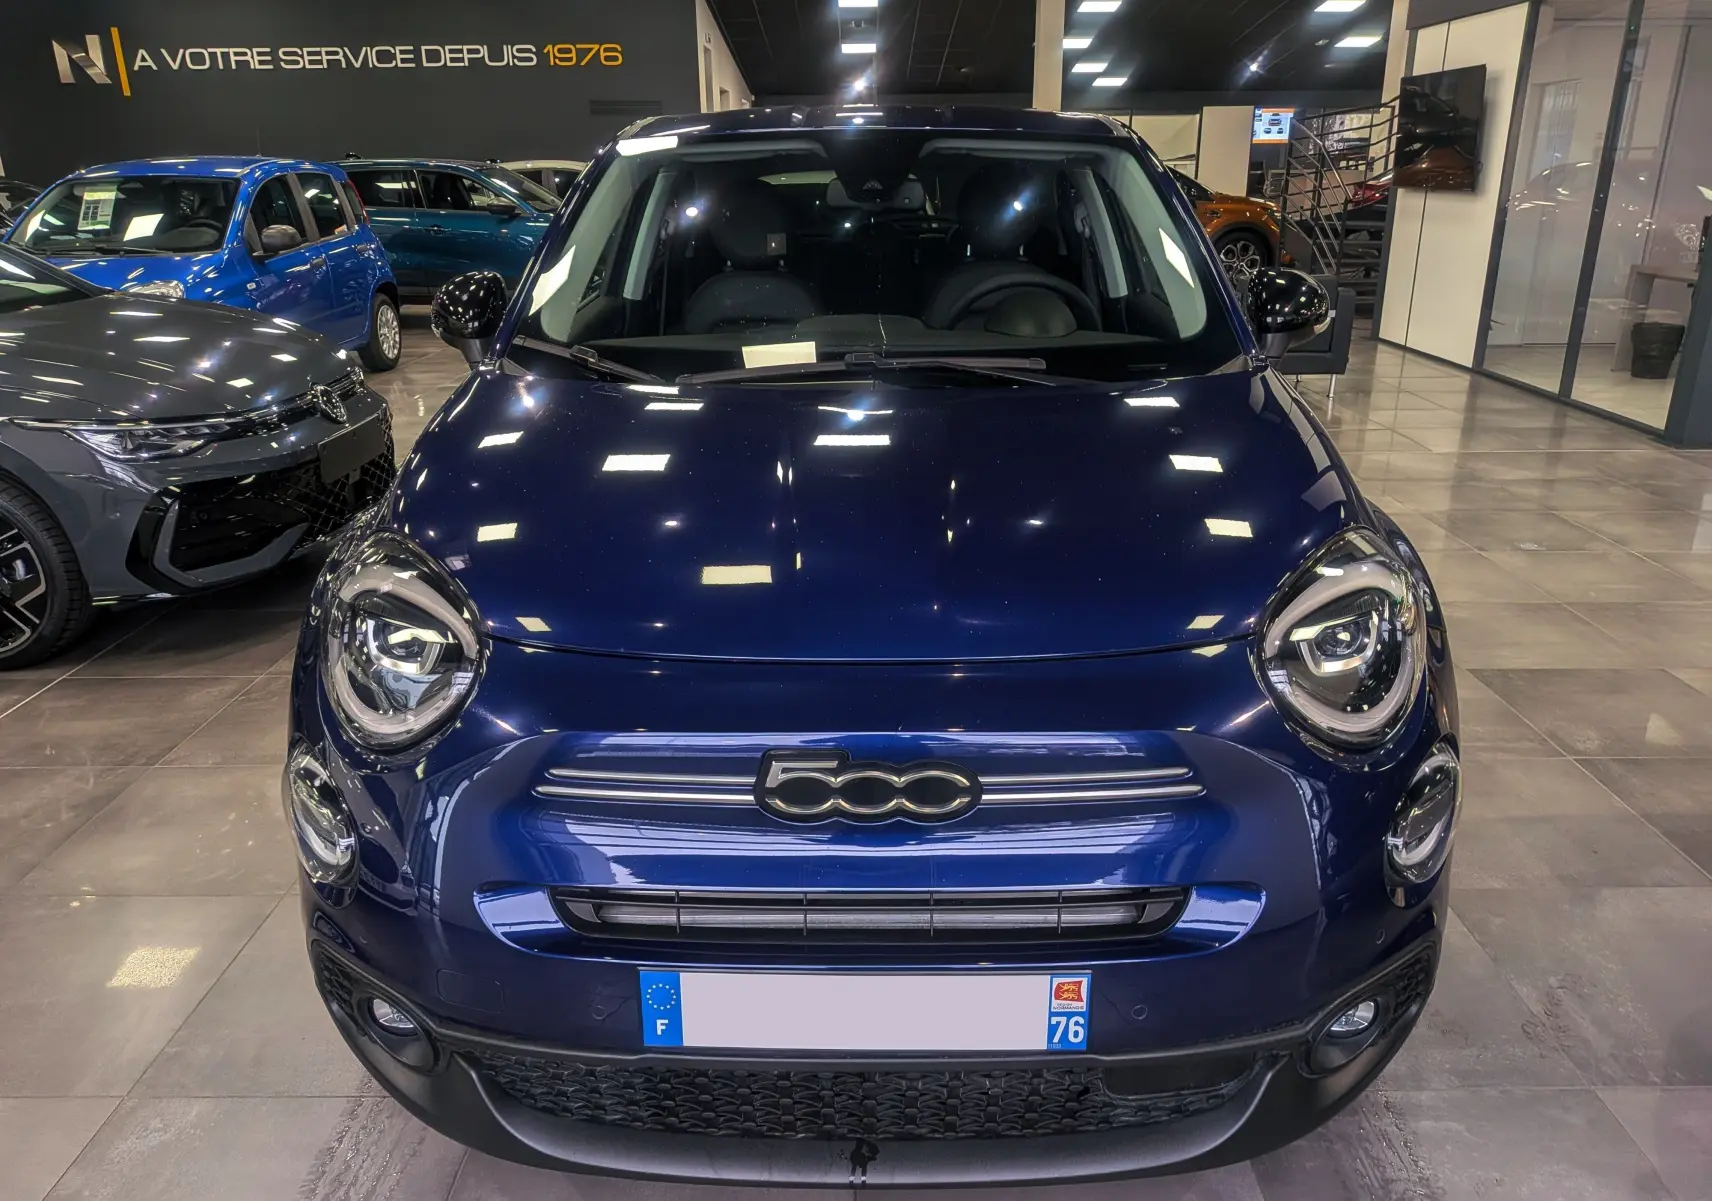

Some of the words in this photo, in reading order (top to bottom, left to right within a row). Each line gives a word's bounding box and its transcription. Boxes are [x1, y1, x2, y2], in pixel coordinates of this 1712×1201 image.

[133, 48, 158, 71] A
[160, 47, 274, 70] VOTRE
[278, 45, 416, 69] SERVICE
[420, 44, 538, 67] DEPUIS
[543, 43, 623, 67] 1976
[764, 760, 971, 815] 500
[656, 1019, 669, 1035] F
[1051, 1016, 1085, 1043] 76
